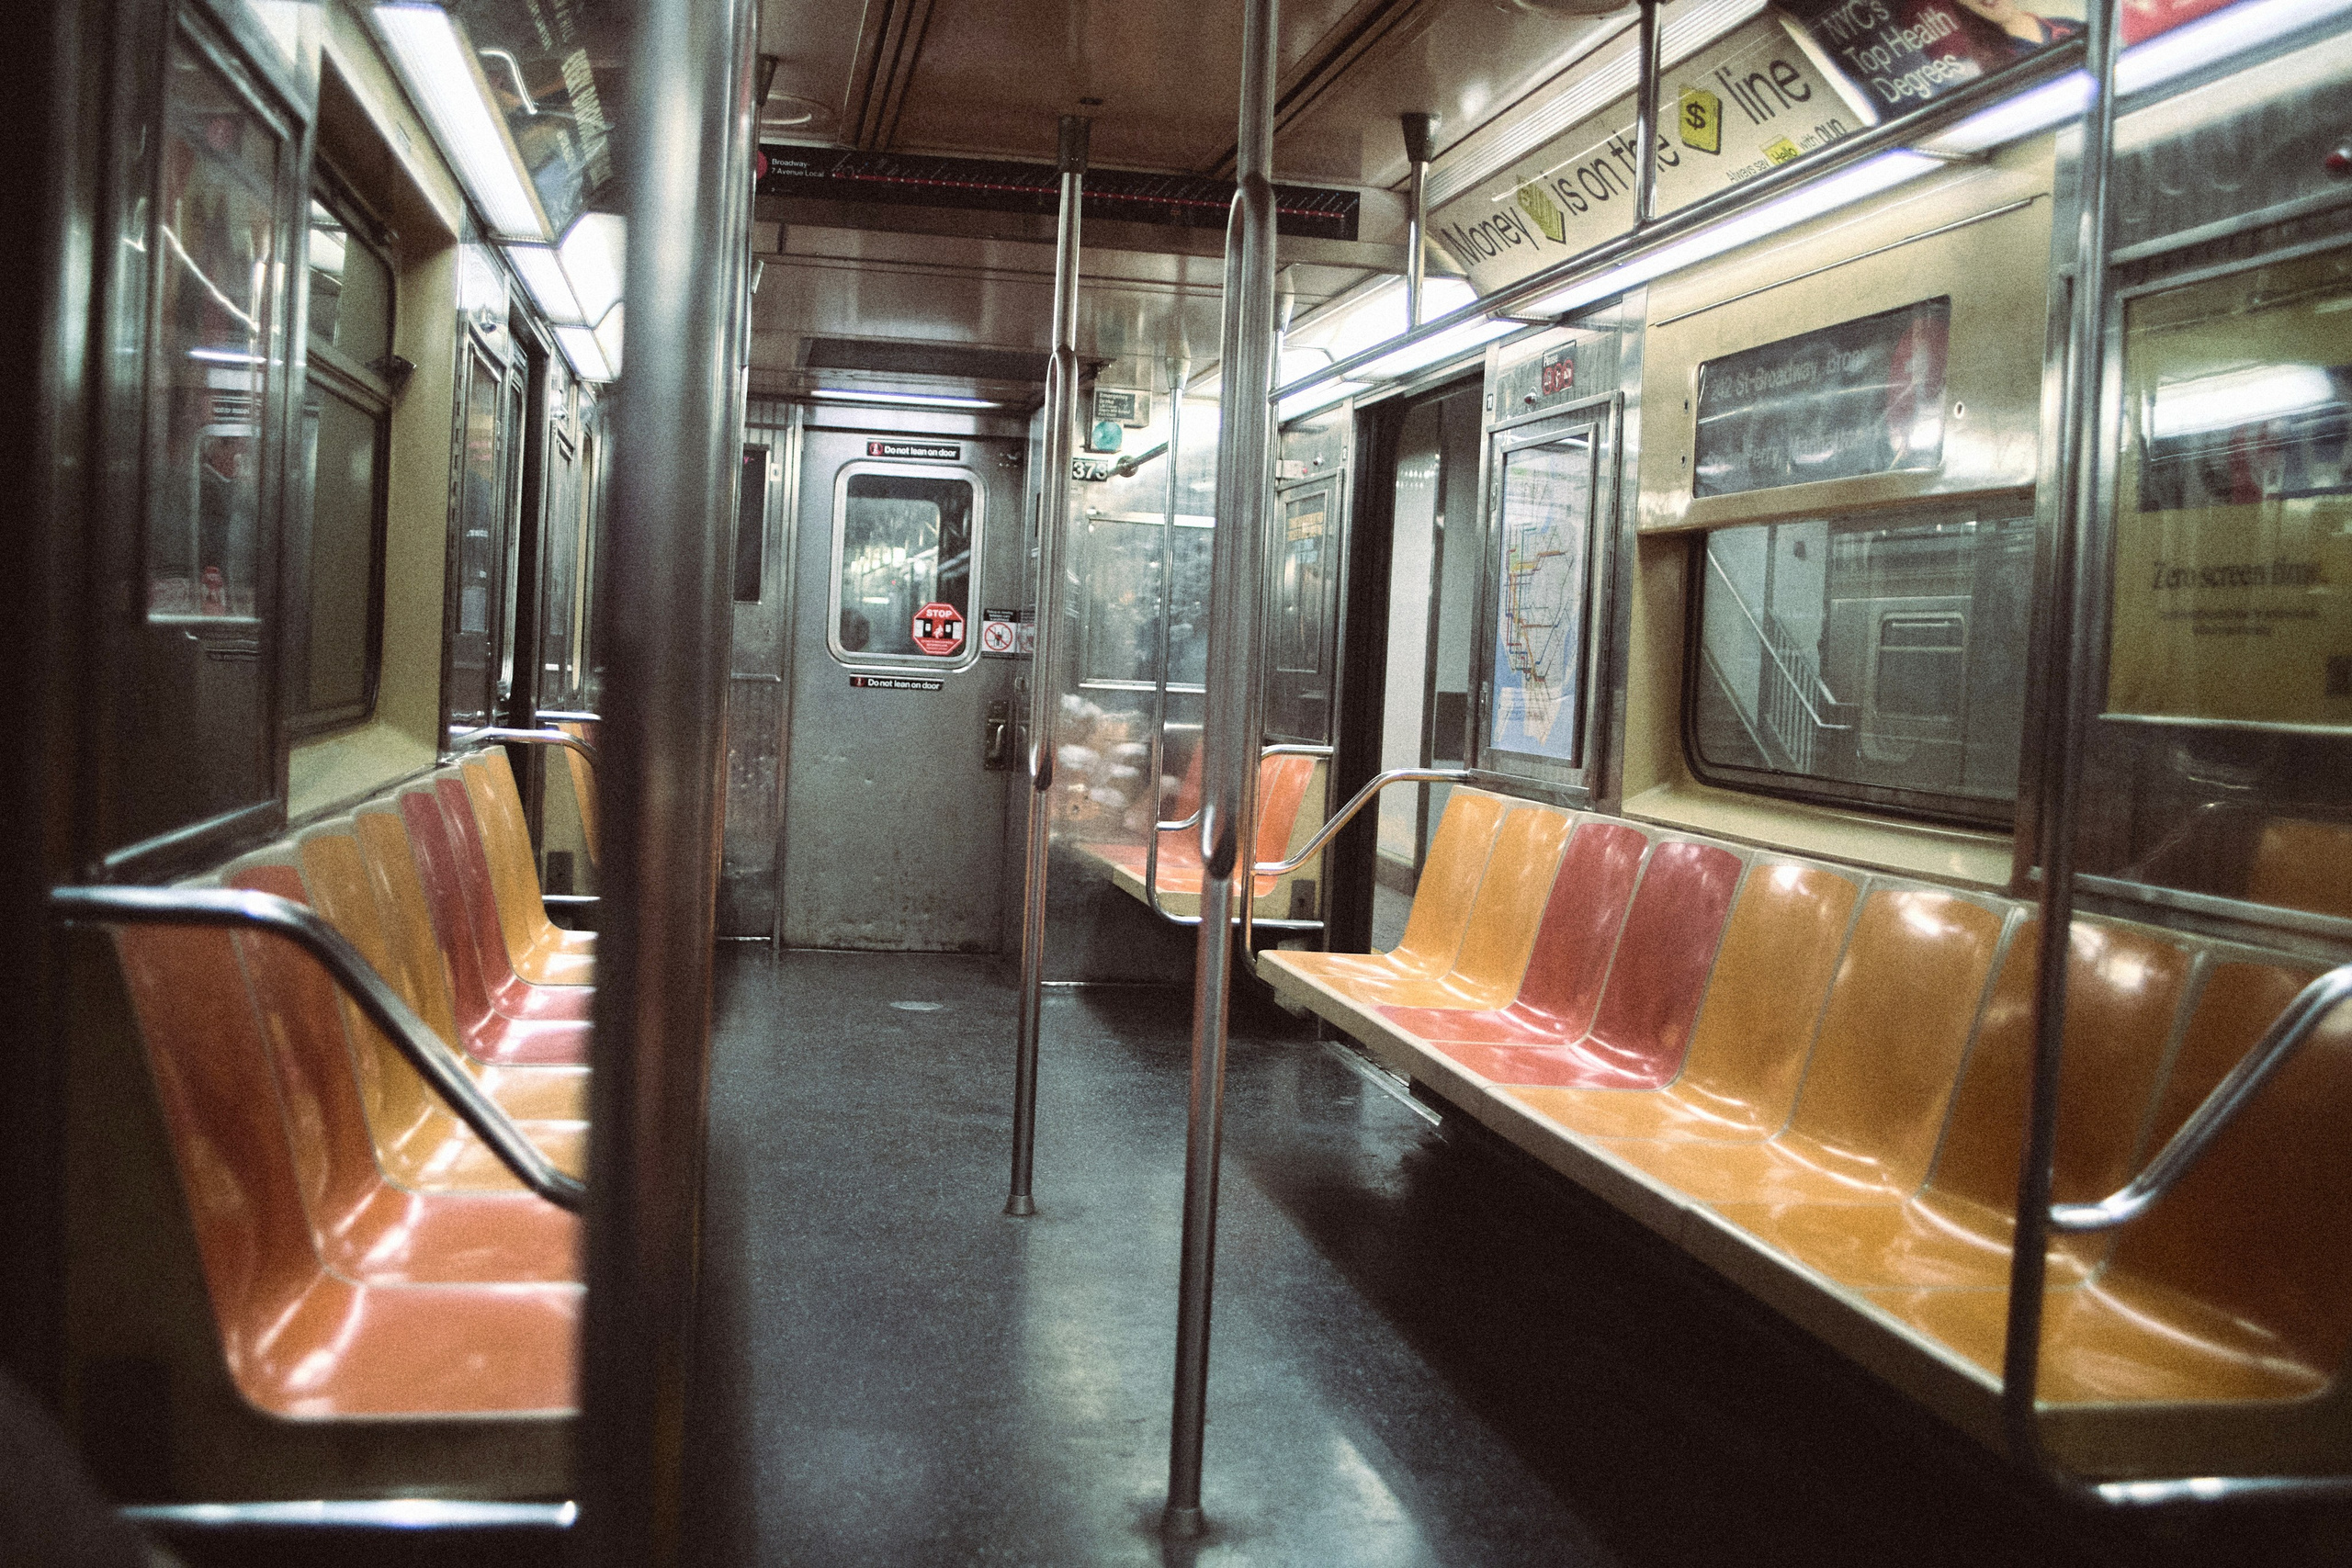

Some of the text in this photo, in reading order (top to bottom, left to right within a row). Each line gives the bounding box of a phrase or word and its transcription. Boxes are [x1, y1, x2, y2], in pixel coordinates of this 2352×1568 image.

[1824, 0, 1890, 43] NYC's
[1842, 7, 1962, 74] Top Health
[1871, 53, 1965, 103] Degrees
[1442, 206, 1540, 266] Money
[1540, 171, 1589, 216] is
[1577, 158, 1630, 202] on
[1715, 59, 1812, 126] line
[1771, 146, 1798, 164] Hello
[1798, 134, 1820, 152] with
[776, 168, 805, 177] Avenue
[805, 169, 825, 178] Local
[884, 446, 896, 455] Do
[896, 446, 910, 456] not
[910, 447, 927, 457] lean
[938, 448, 956, 457] door
[926, 609, 953, 618] STOP
[922, 682, 940, 690] door
